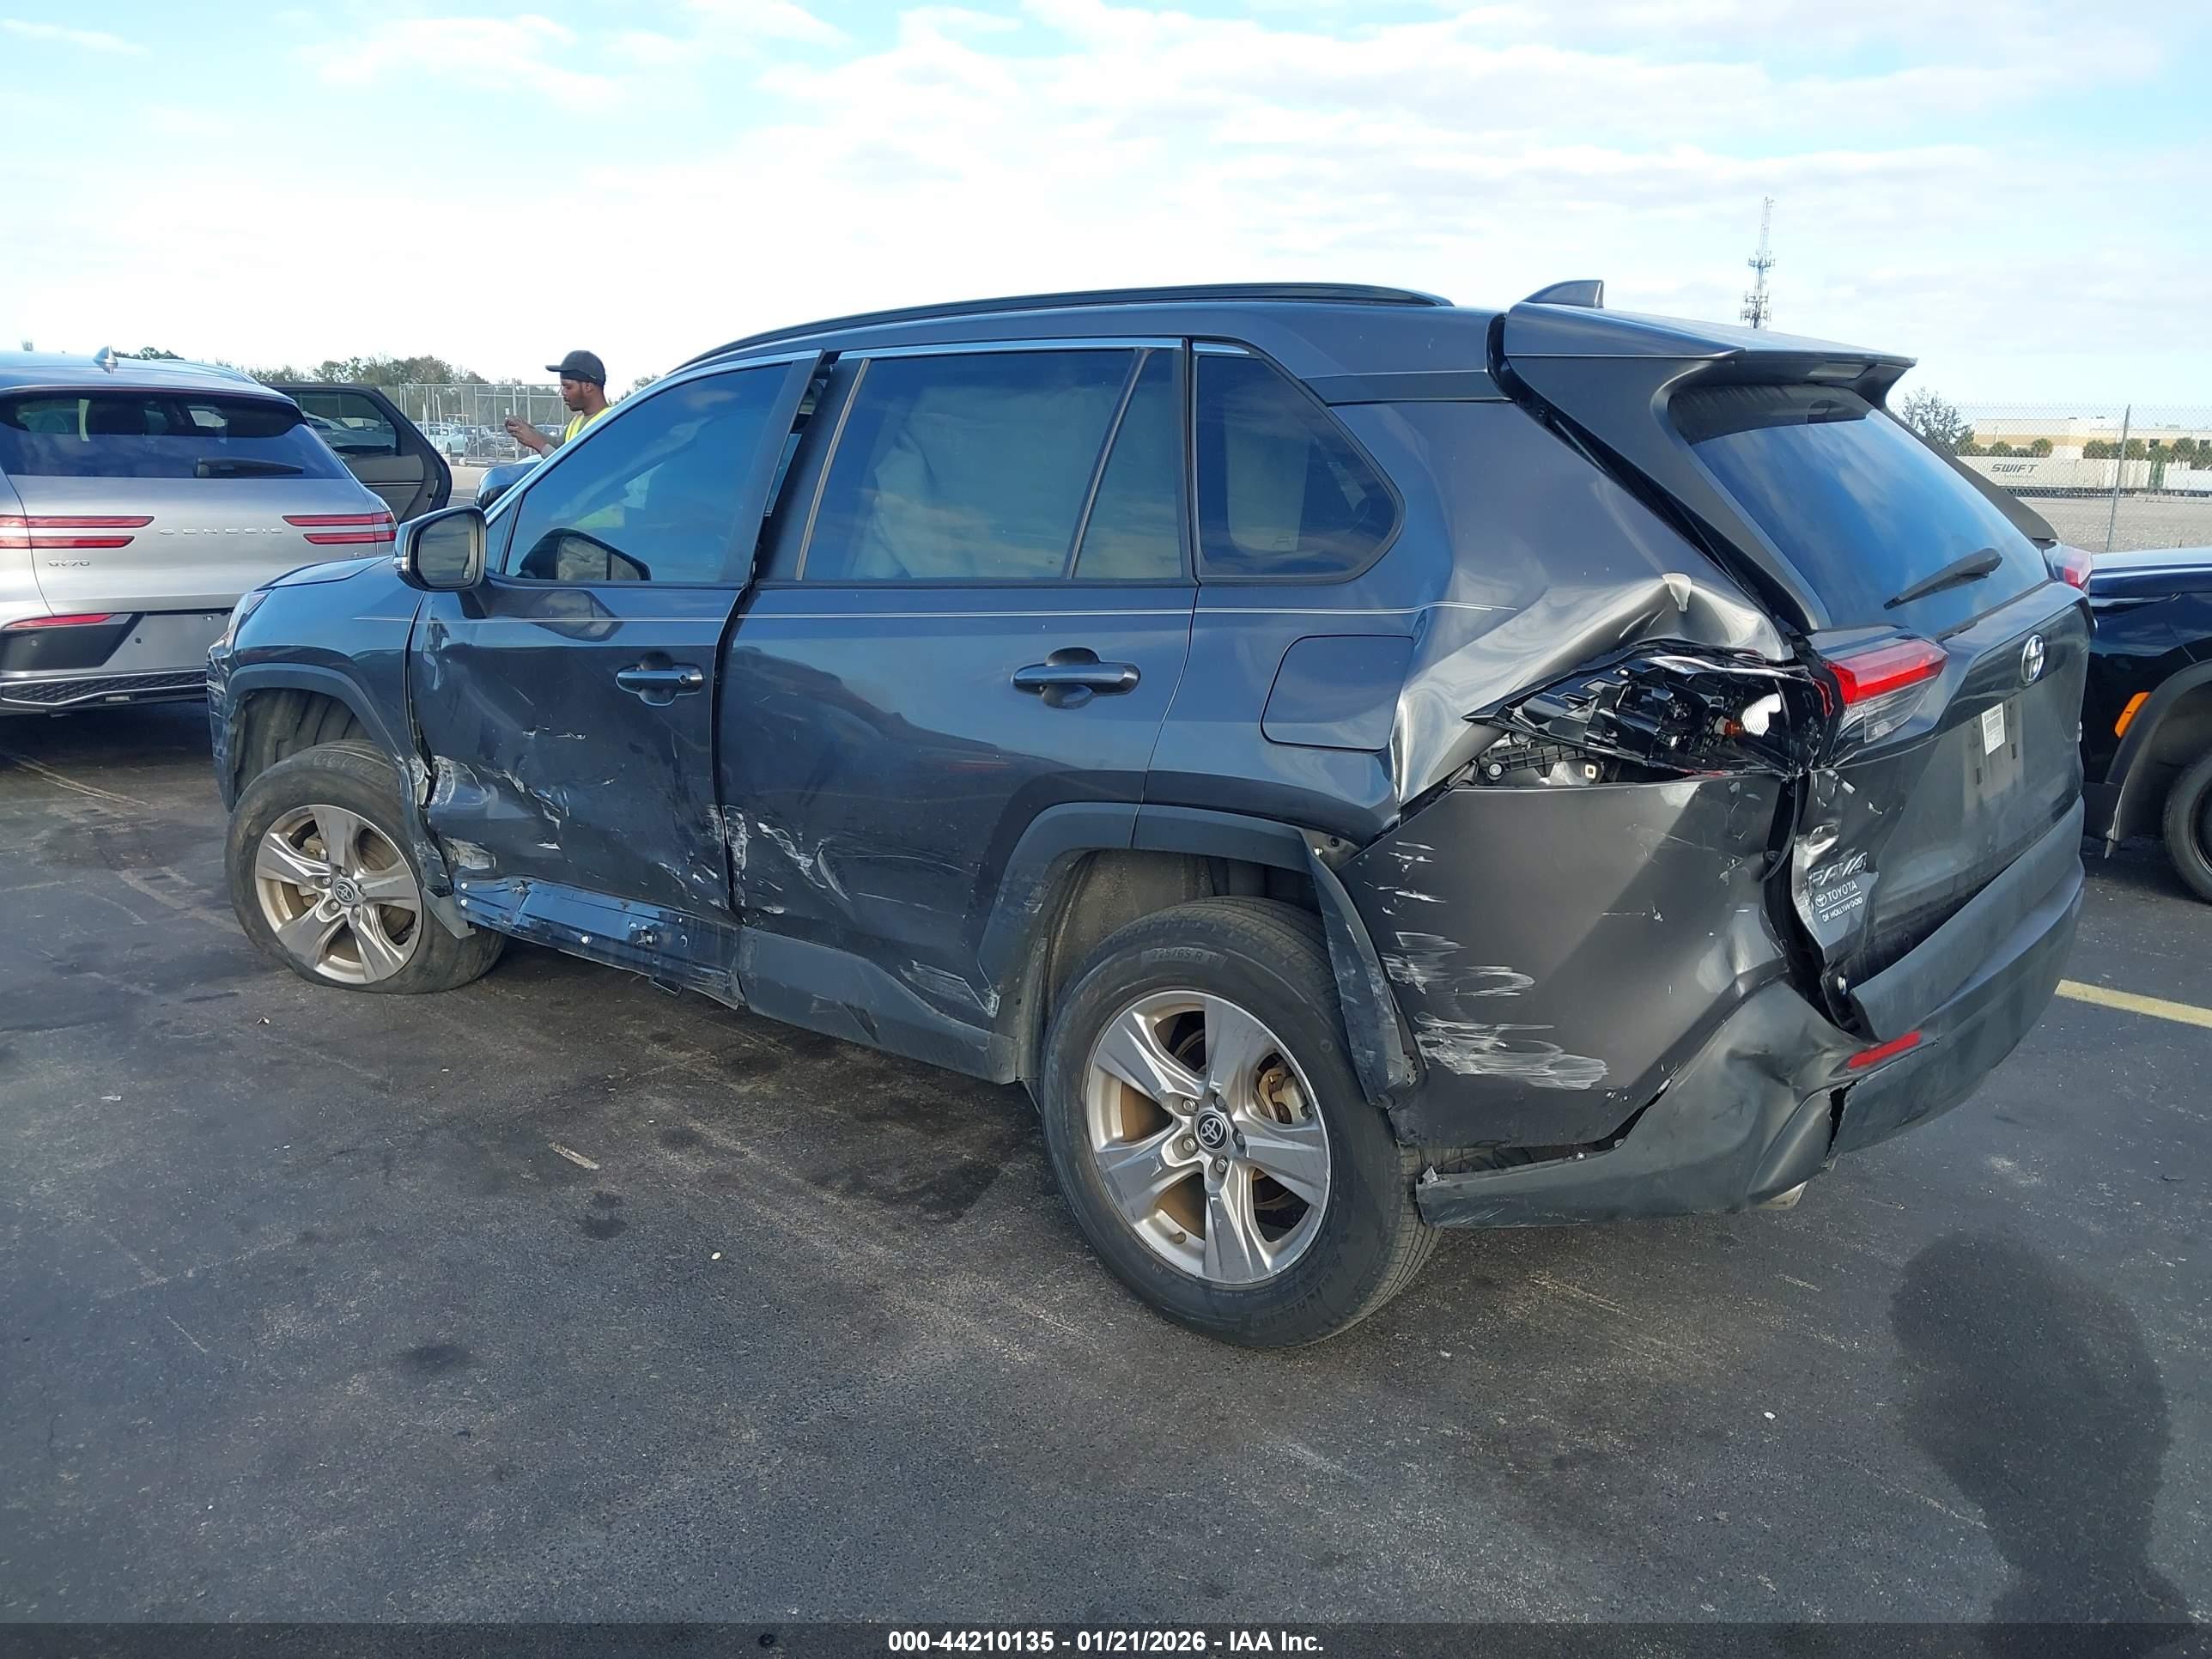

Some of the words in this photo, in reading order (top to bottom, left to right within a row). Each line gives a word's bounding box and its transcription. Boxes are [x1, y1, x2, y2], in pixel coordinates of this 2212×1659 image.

[1991, 464, 2039, 473] SWIFT
[1826, 879, 1858, 902] TOYOTA
[1821, 913, 1830, 922] OF
[1829, 896, 1863, 919] HOLLYWOOD
